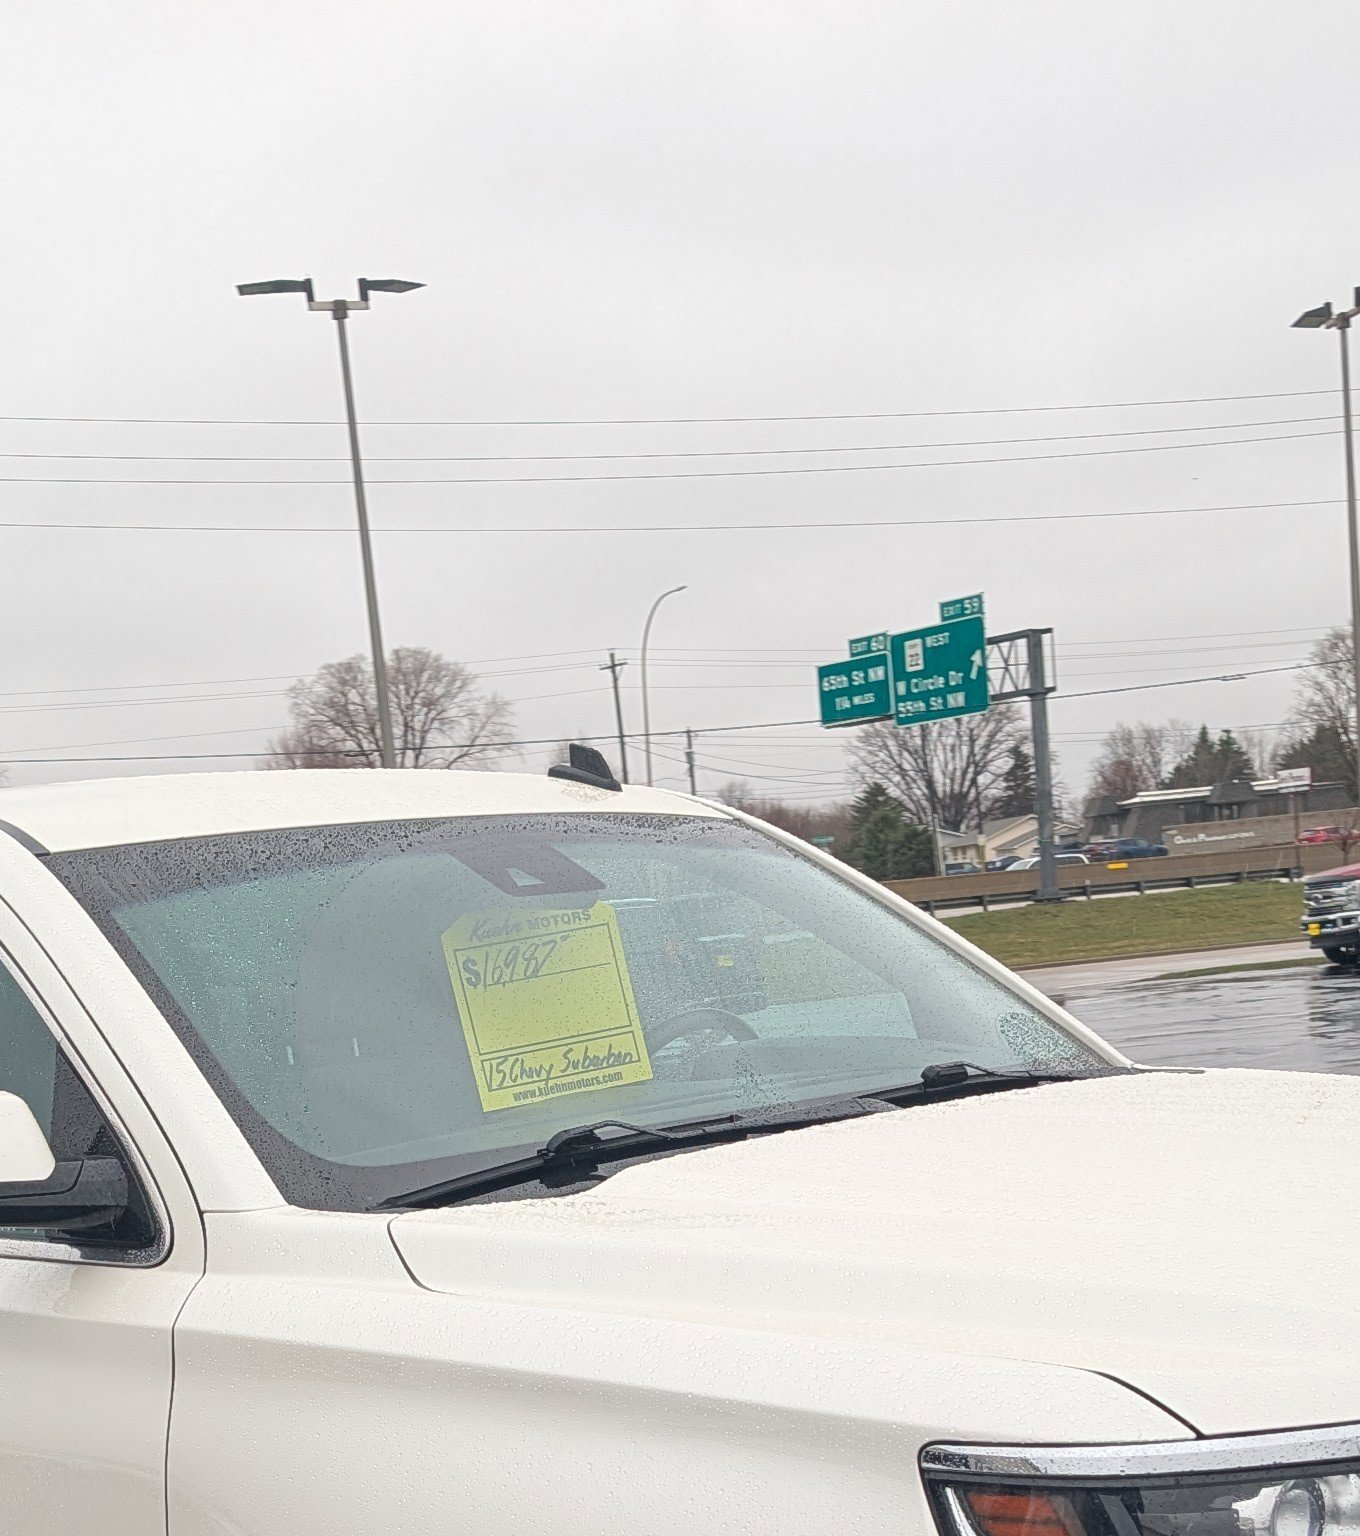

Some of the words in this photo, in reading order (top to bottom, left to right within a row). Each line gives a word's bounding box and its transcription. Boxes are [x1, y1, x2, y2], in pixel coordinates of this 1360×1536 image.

[851, 670, 866, 686] St
[910, 674, 946, 694] Circle
[948, 670, 964, 686] Dr
[929, 694, 944, 711] St
[527, 908, 592, 931] MOTORS
[512, 1070, 624, 1102] www.kuehnmotors.com
